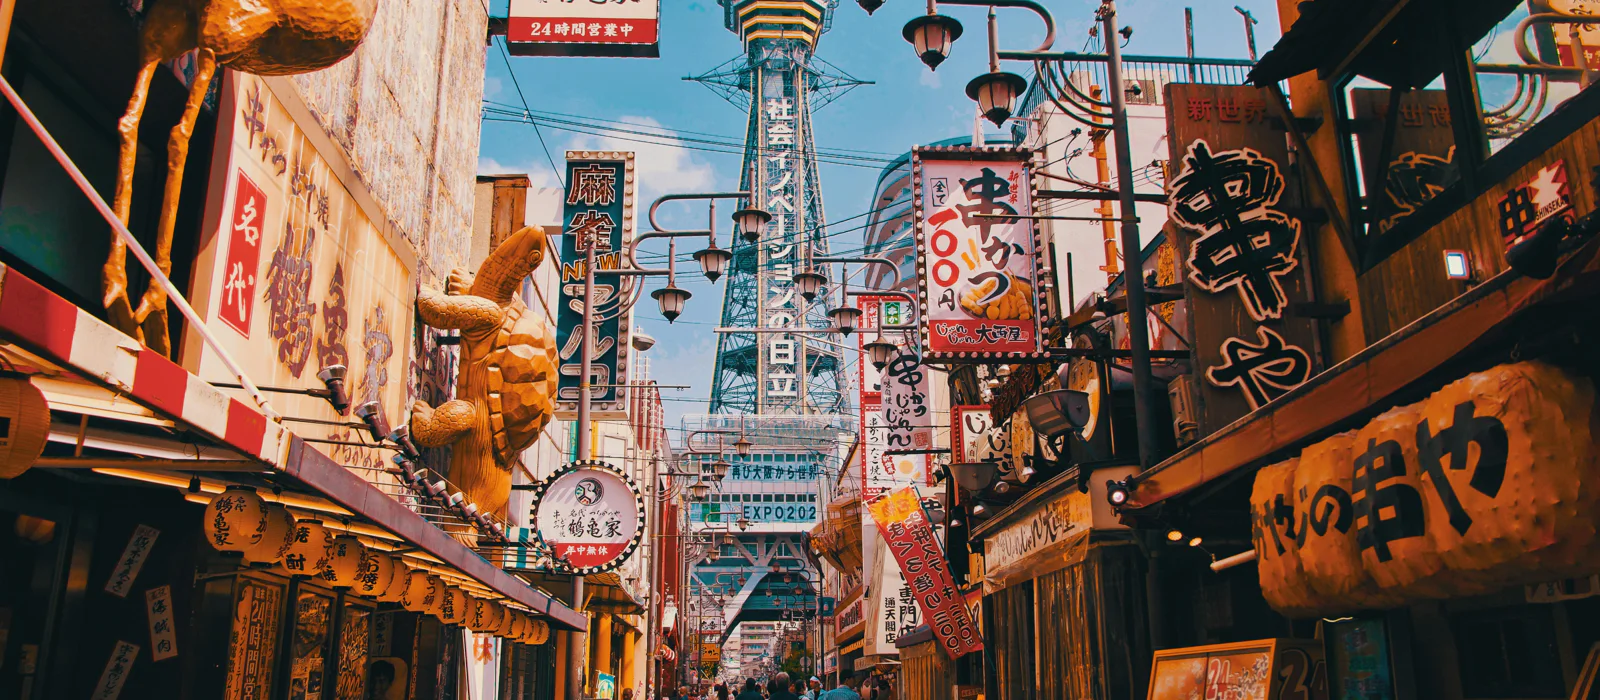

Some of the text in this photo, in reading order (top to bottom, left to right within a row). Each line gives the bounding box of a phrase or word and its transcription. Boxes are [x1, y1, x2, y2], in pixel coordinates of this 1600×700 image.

[530, 21, 634, 37] 24時間営業中
[1187, 96, 1268, 124] 新世界
[565, 163, 617, 252] 麻雀
[933, 180, 947, 205] 全て
[1007, 170, 1019, 205] 新世界
[1535, 197, 1569, 221] SHINSEKA
[766, 98, 795, 398] 社会イノベーションの日立
[955, 167, 1025, 306] 串かつ
[224, 196, 260, 323] 名代
[1169, 138, 1311, 411] 串や
[558, 283, 615, 400] マルコ
[213, 496, 234, 546] 鶴亀家
[567, 516, 623, 538] 鶴亀家
[743, 505, 816, 520] EXPO202
[566, 545, 608, 556] 年中無休
[884, 597, 897, 644] 通天閣店
